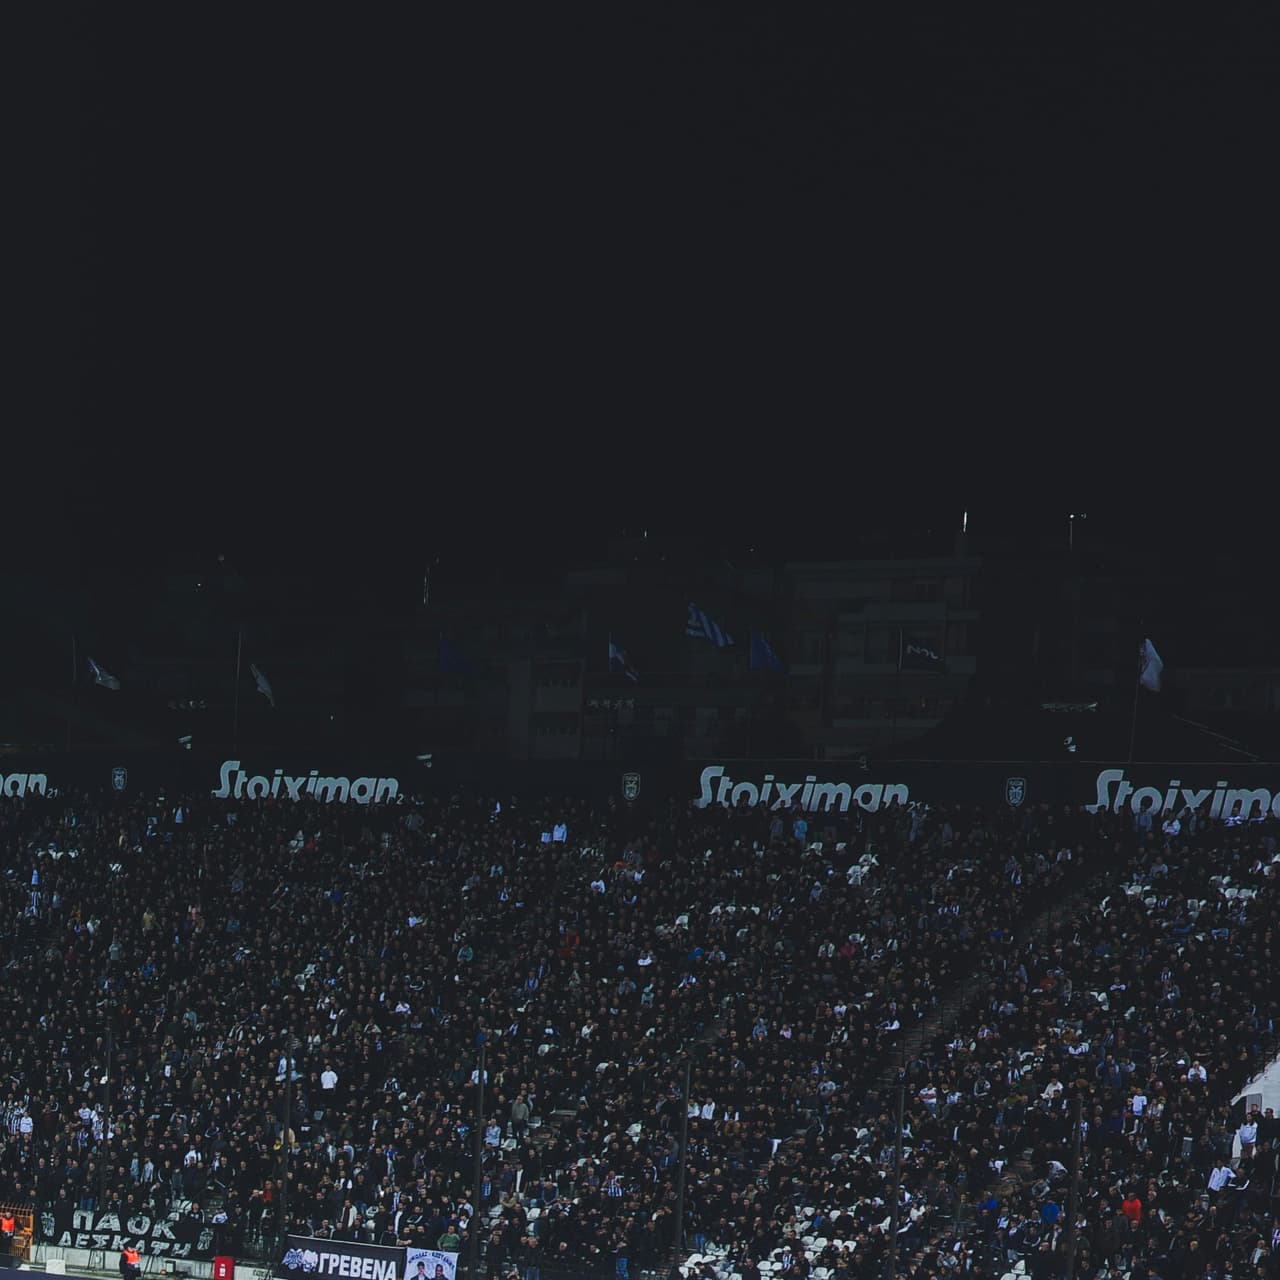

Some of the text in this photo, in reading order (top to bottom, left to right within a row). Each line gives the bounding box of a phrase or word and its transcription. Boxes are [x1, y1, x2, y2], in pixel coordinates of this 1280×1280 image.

[211, 760, 399, 804] Stoiximan
[693, 766, 909, 812] Stoiximan
[1085, 769, 1280, 820] Stoixim
[73, 1210, 176, 1240] ΠΑΟΚ
